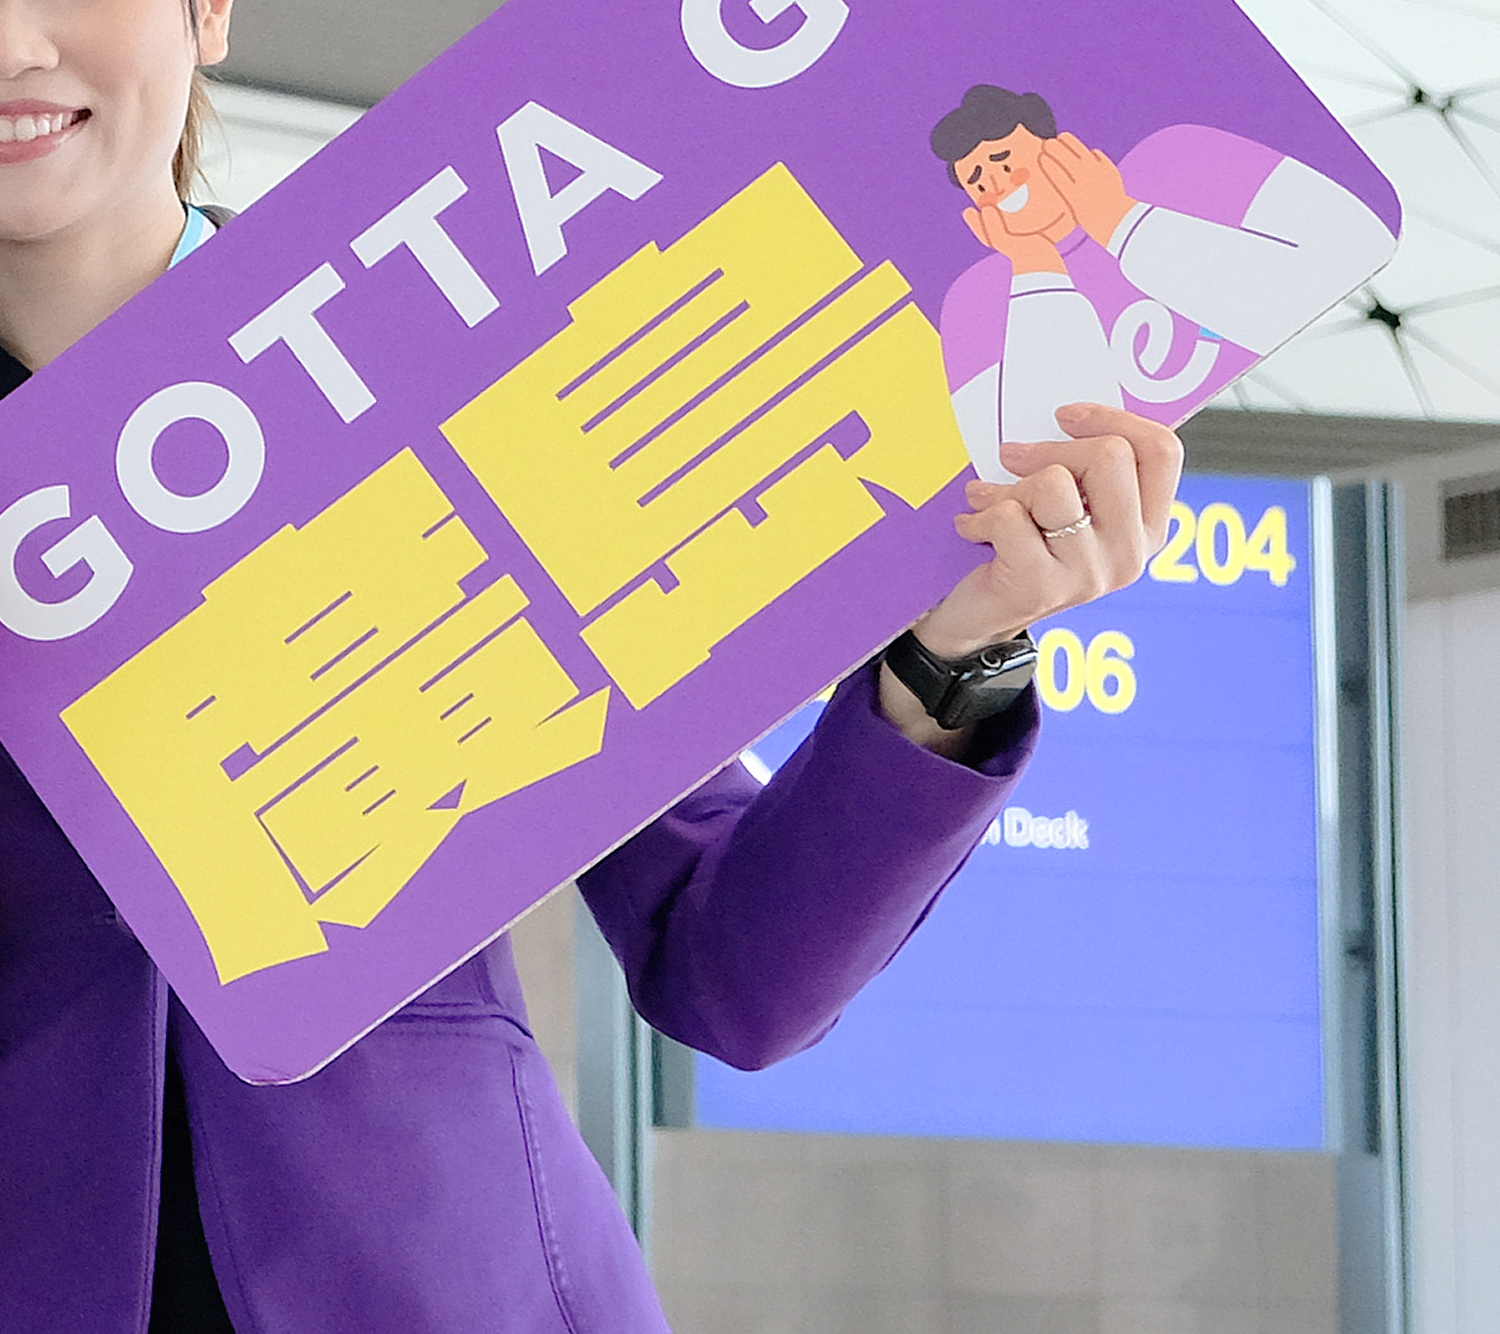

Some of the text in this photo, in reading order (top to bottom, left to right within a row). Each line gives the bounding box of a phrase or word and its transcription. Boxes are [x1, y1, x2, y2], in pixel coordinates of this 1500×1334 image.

[60, 162, 973, 985] 廣島
[1149, 481, 1297, 587] 204
[1036, 627, 1138, 714] 06
